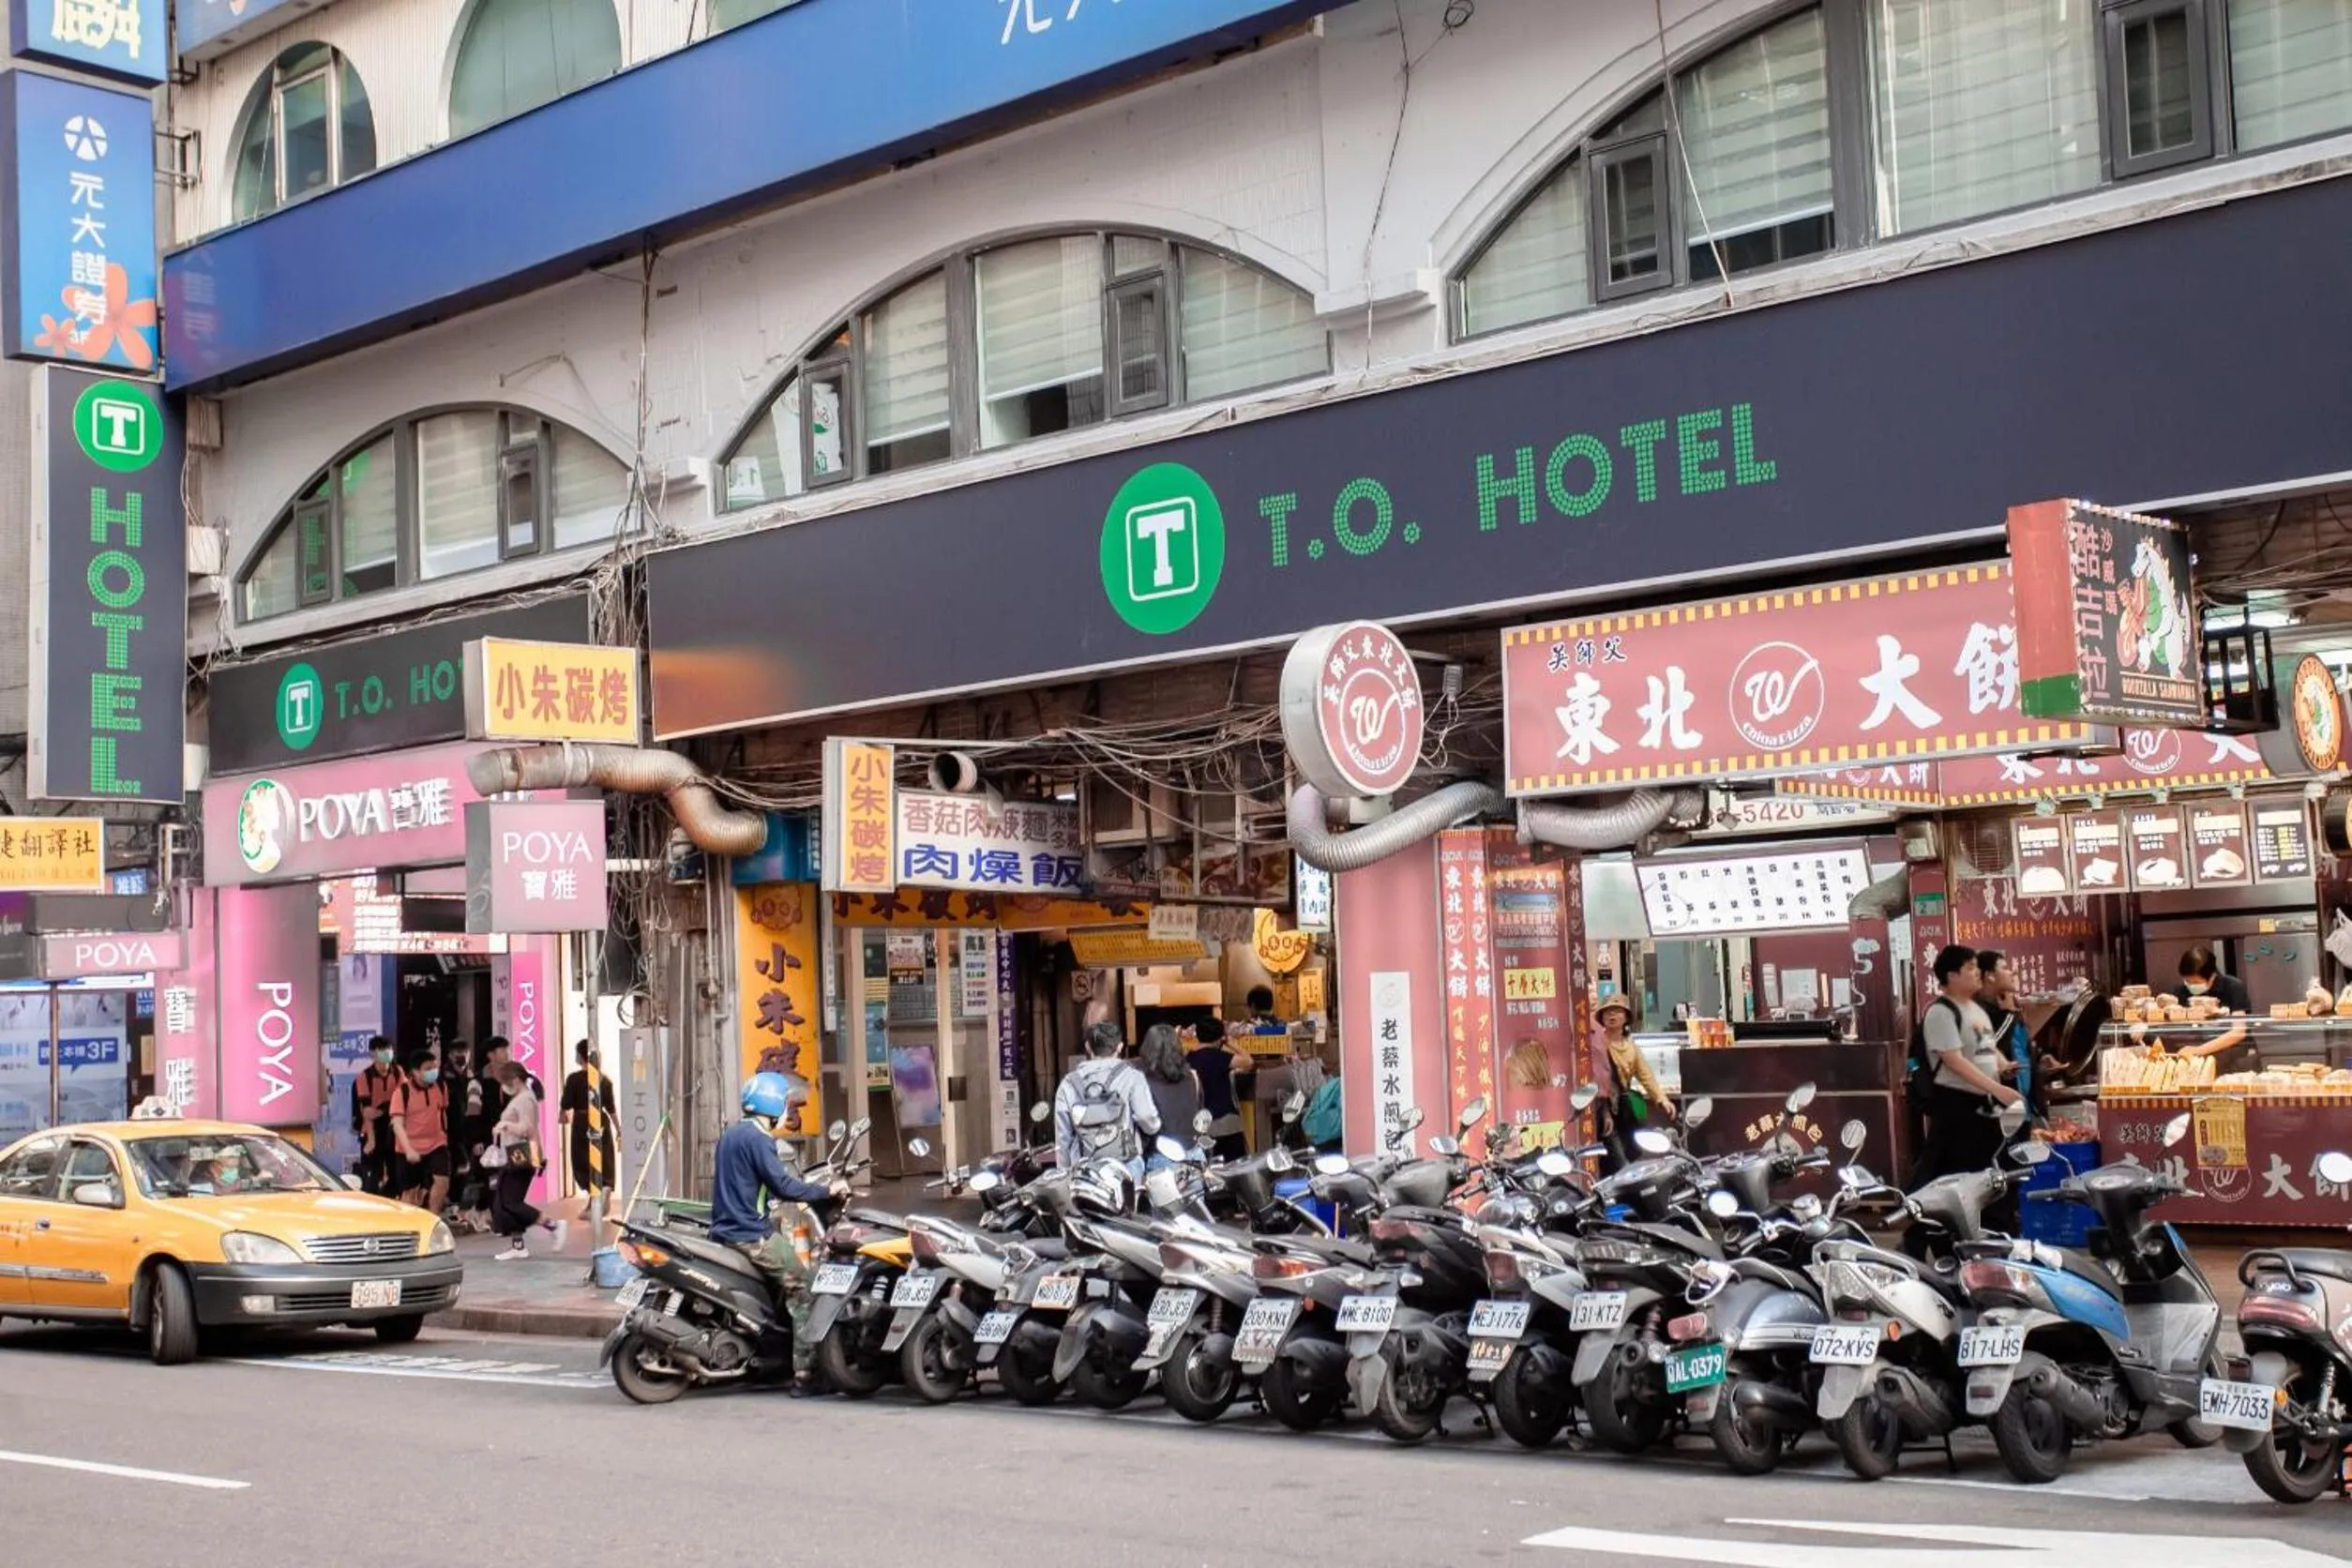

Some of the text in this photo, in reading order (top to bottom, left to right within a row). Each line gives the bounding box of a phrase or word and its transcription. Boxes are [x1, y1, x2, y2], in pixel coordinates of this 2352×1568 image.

[69, 172, 107, 325] 元大證券
[1259, 402, 1777, 567] T.O. HOTEL
[87, 488, 144, 794] HOTEL
[335, 659, 464, 720] T.O. HO
[495, 662, 629, 727] 小朱碳烤
[1555, 666, 1705, 767] 東北
[298, 776, 456, 843] POYA 寶雅
[850, 753, 887, 884] 小朱碳烤
[502, 831, 595, 865] POYA
[903, 843, 1084, 887] 肉燥飯
[521, 868, 579, 901] 寶雅
[75, 942, 158, 968] POYA
[1446, 865, 1469, 999] 東北 大餅
[1470, 864, 1491, 998] 東北 大餅
[255, 982, 294, 1107] POYA
[518, 981, 536, 1063] POYA
[1813, 1335, 1877, 1361] 072-KVS
[1959, 1335, 2022, 1360] 817-LHS
[2201, 1391, 2269, 1421] EMH-7033
